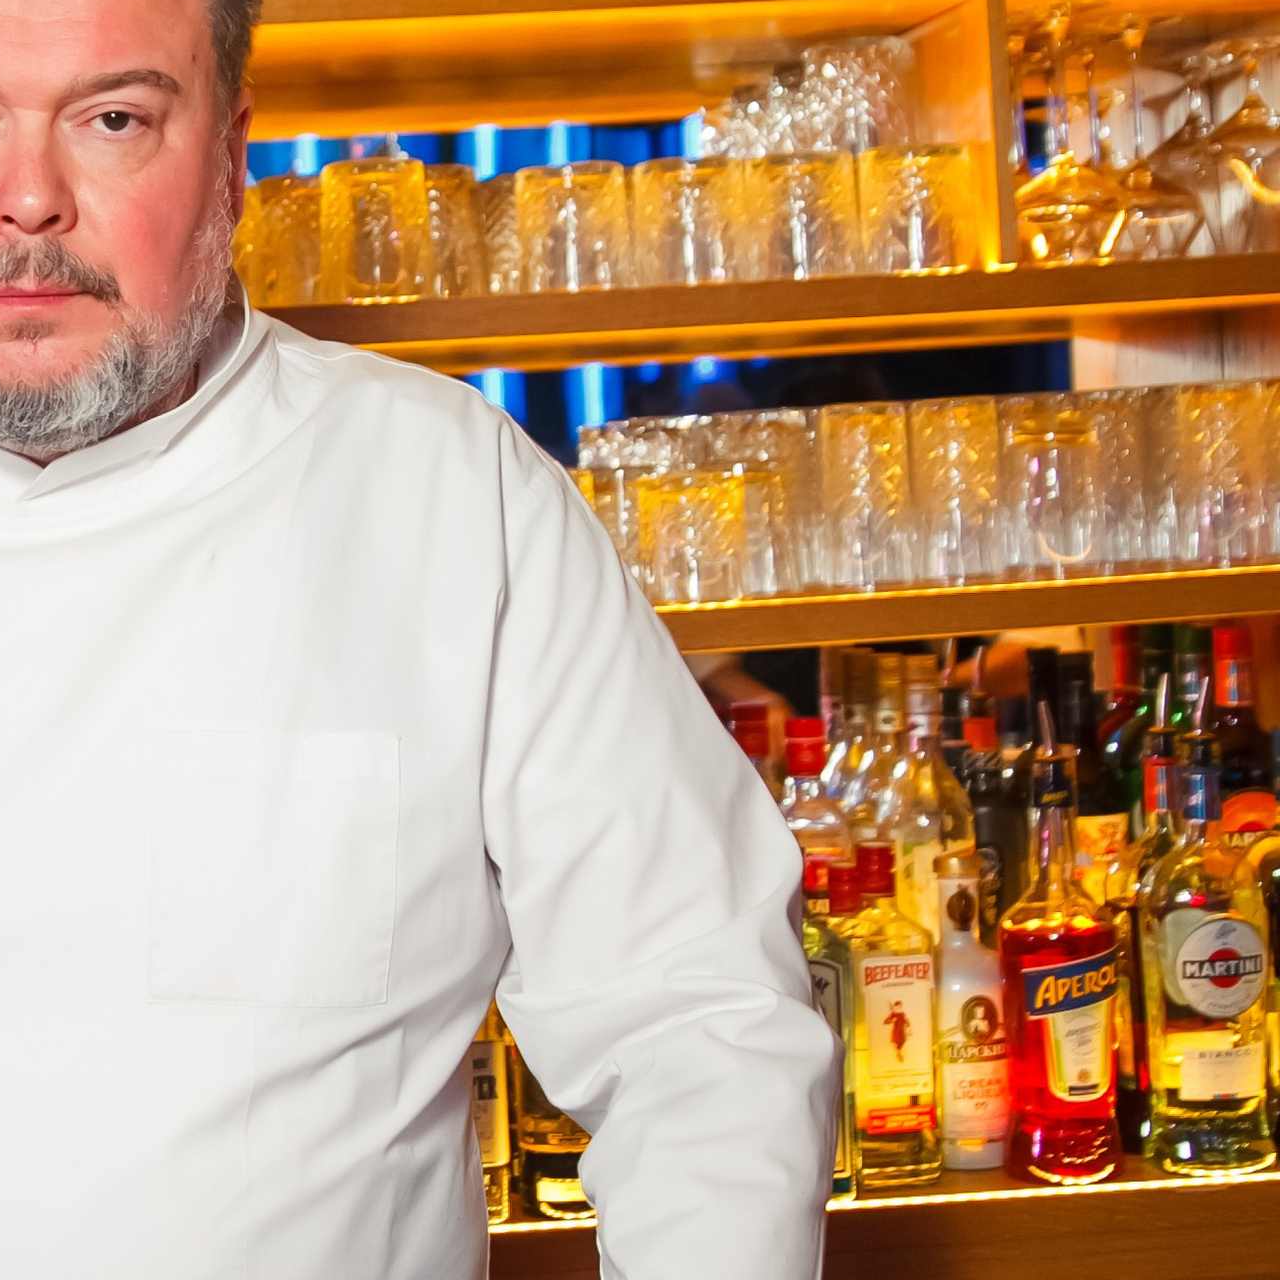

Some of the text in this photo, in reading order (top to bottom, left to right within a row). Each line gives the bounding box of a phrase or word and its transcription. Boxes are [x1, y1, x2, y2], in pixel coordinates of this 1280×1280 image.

[864, 961, 931, 986] BEEFEATER
[1185, 955, 1262, 978] MARTINI
[1034, 964, 1117, 1010] APEROL
[1198, 1045, 1252, 1060] BIANCO
